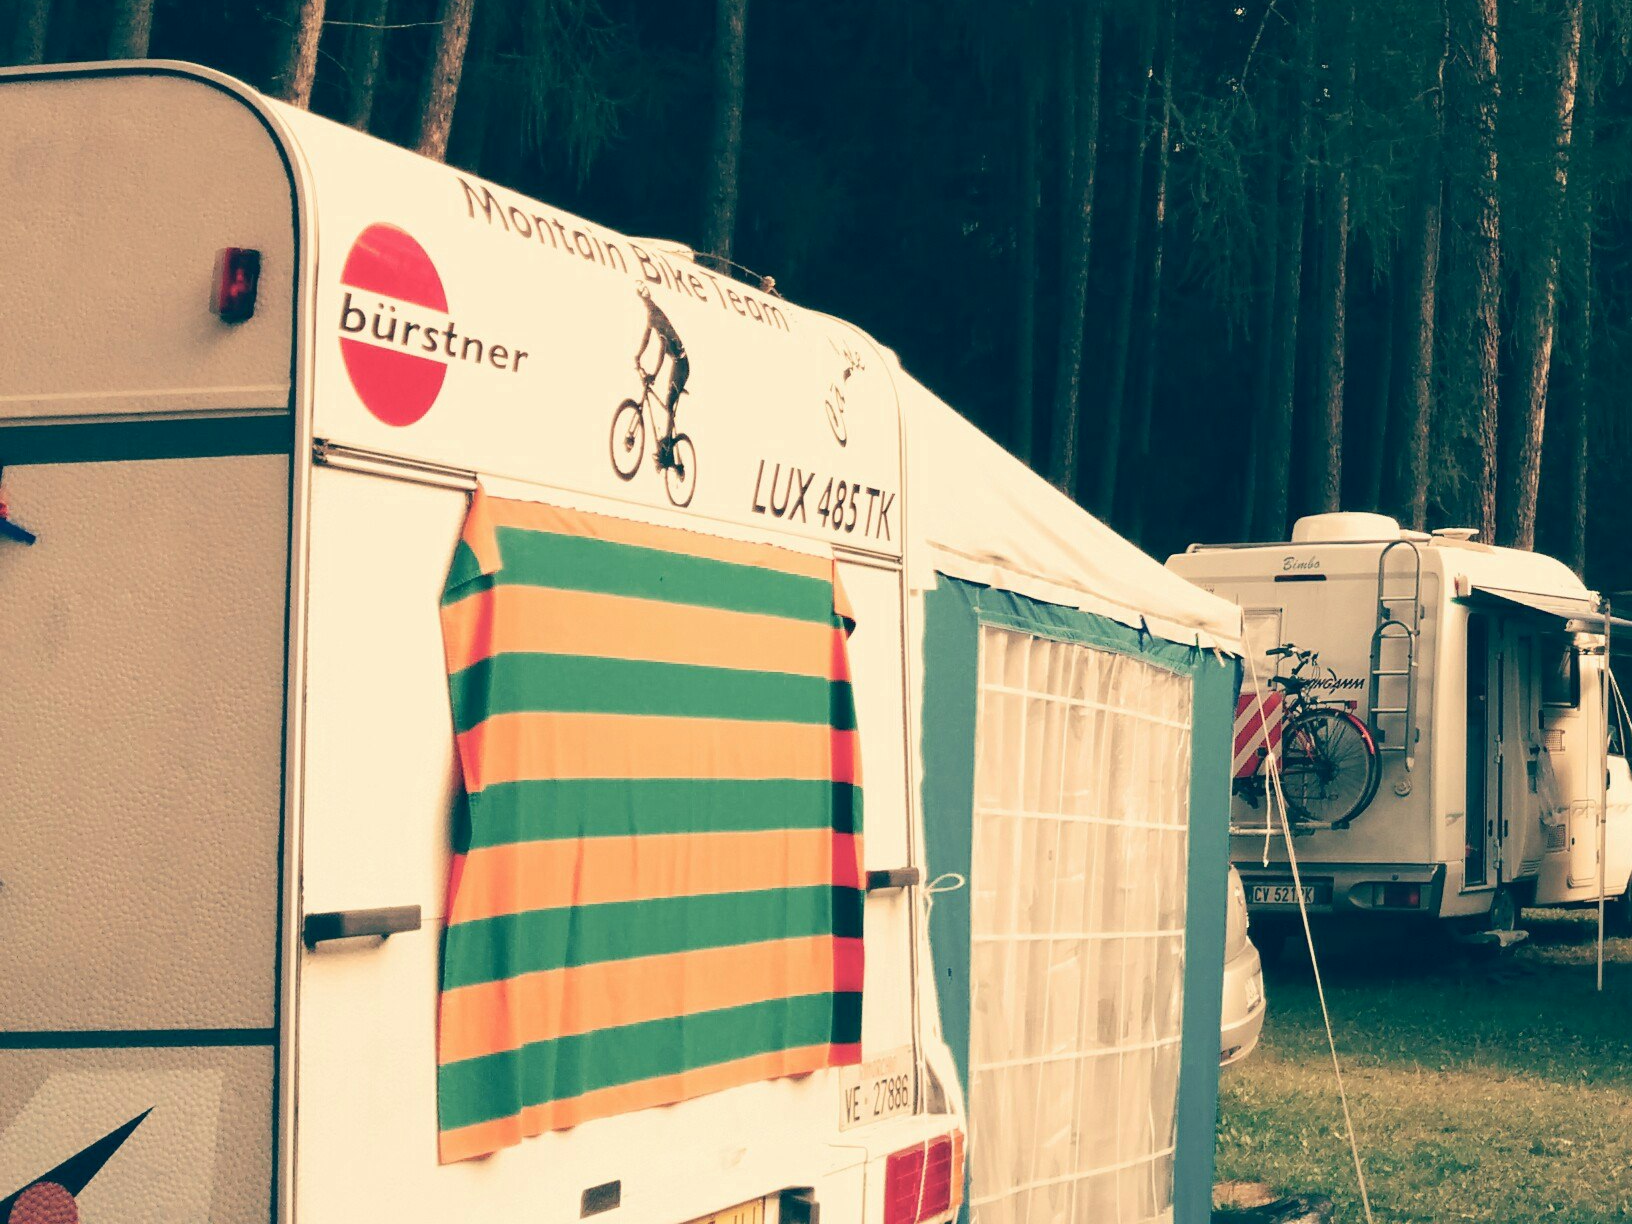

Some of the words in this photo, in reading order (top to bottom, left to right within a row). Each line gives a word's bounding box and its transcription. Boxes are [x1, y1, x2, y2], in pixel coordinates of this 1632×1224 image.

[457, 177, 628, 274] Montain
[627, 242, 708, 303] Bike
[699, 271, 790, 333] Team
[338, 292, 529, 373] bürstner
[751, 459, 816, 524] LUX
[1283, 556, 1320, 571] Bimbo
[1254, 887, 1270, 902] CV
